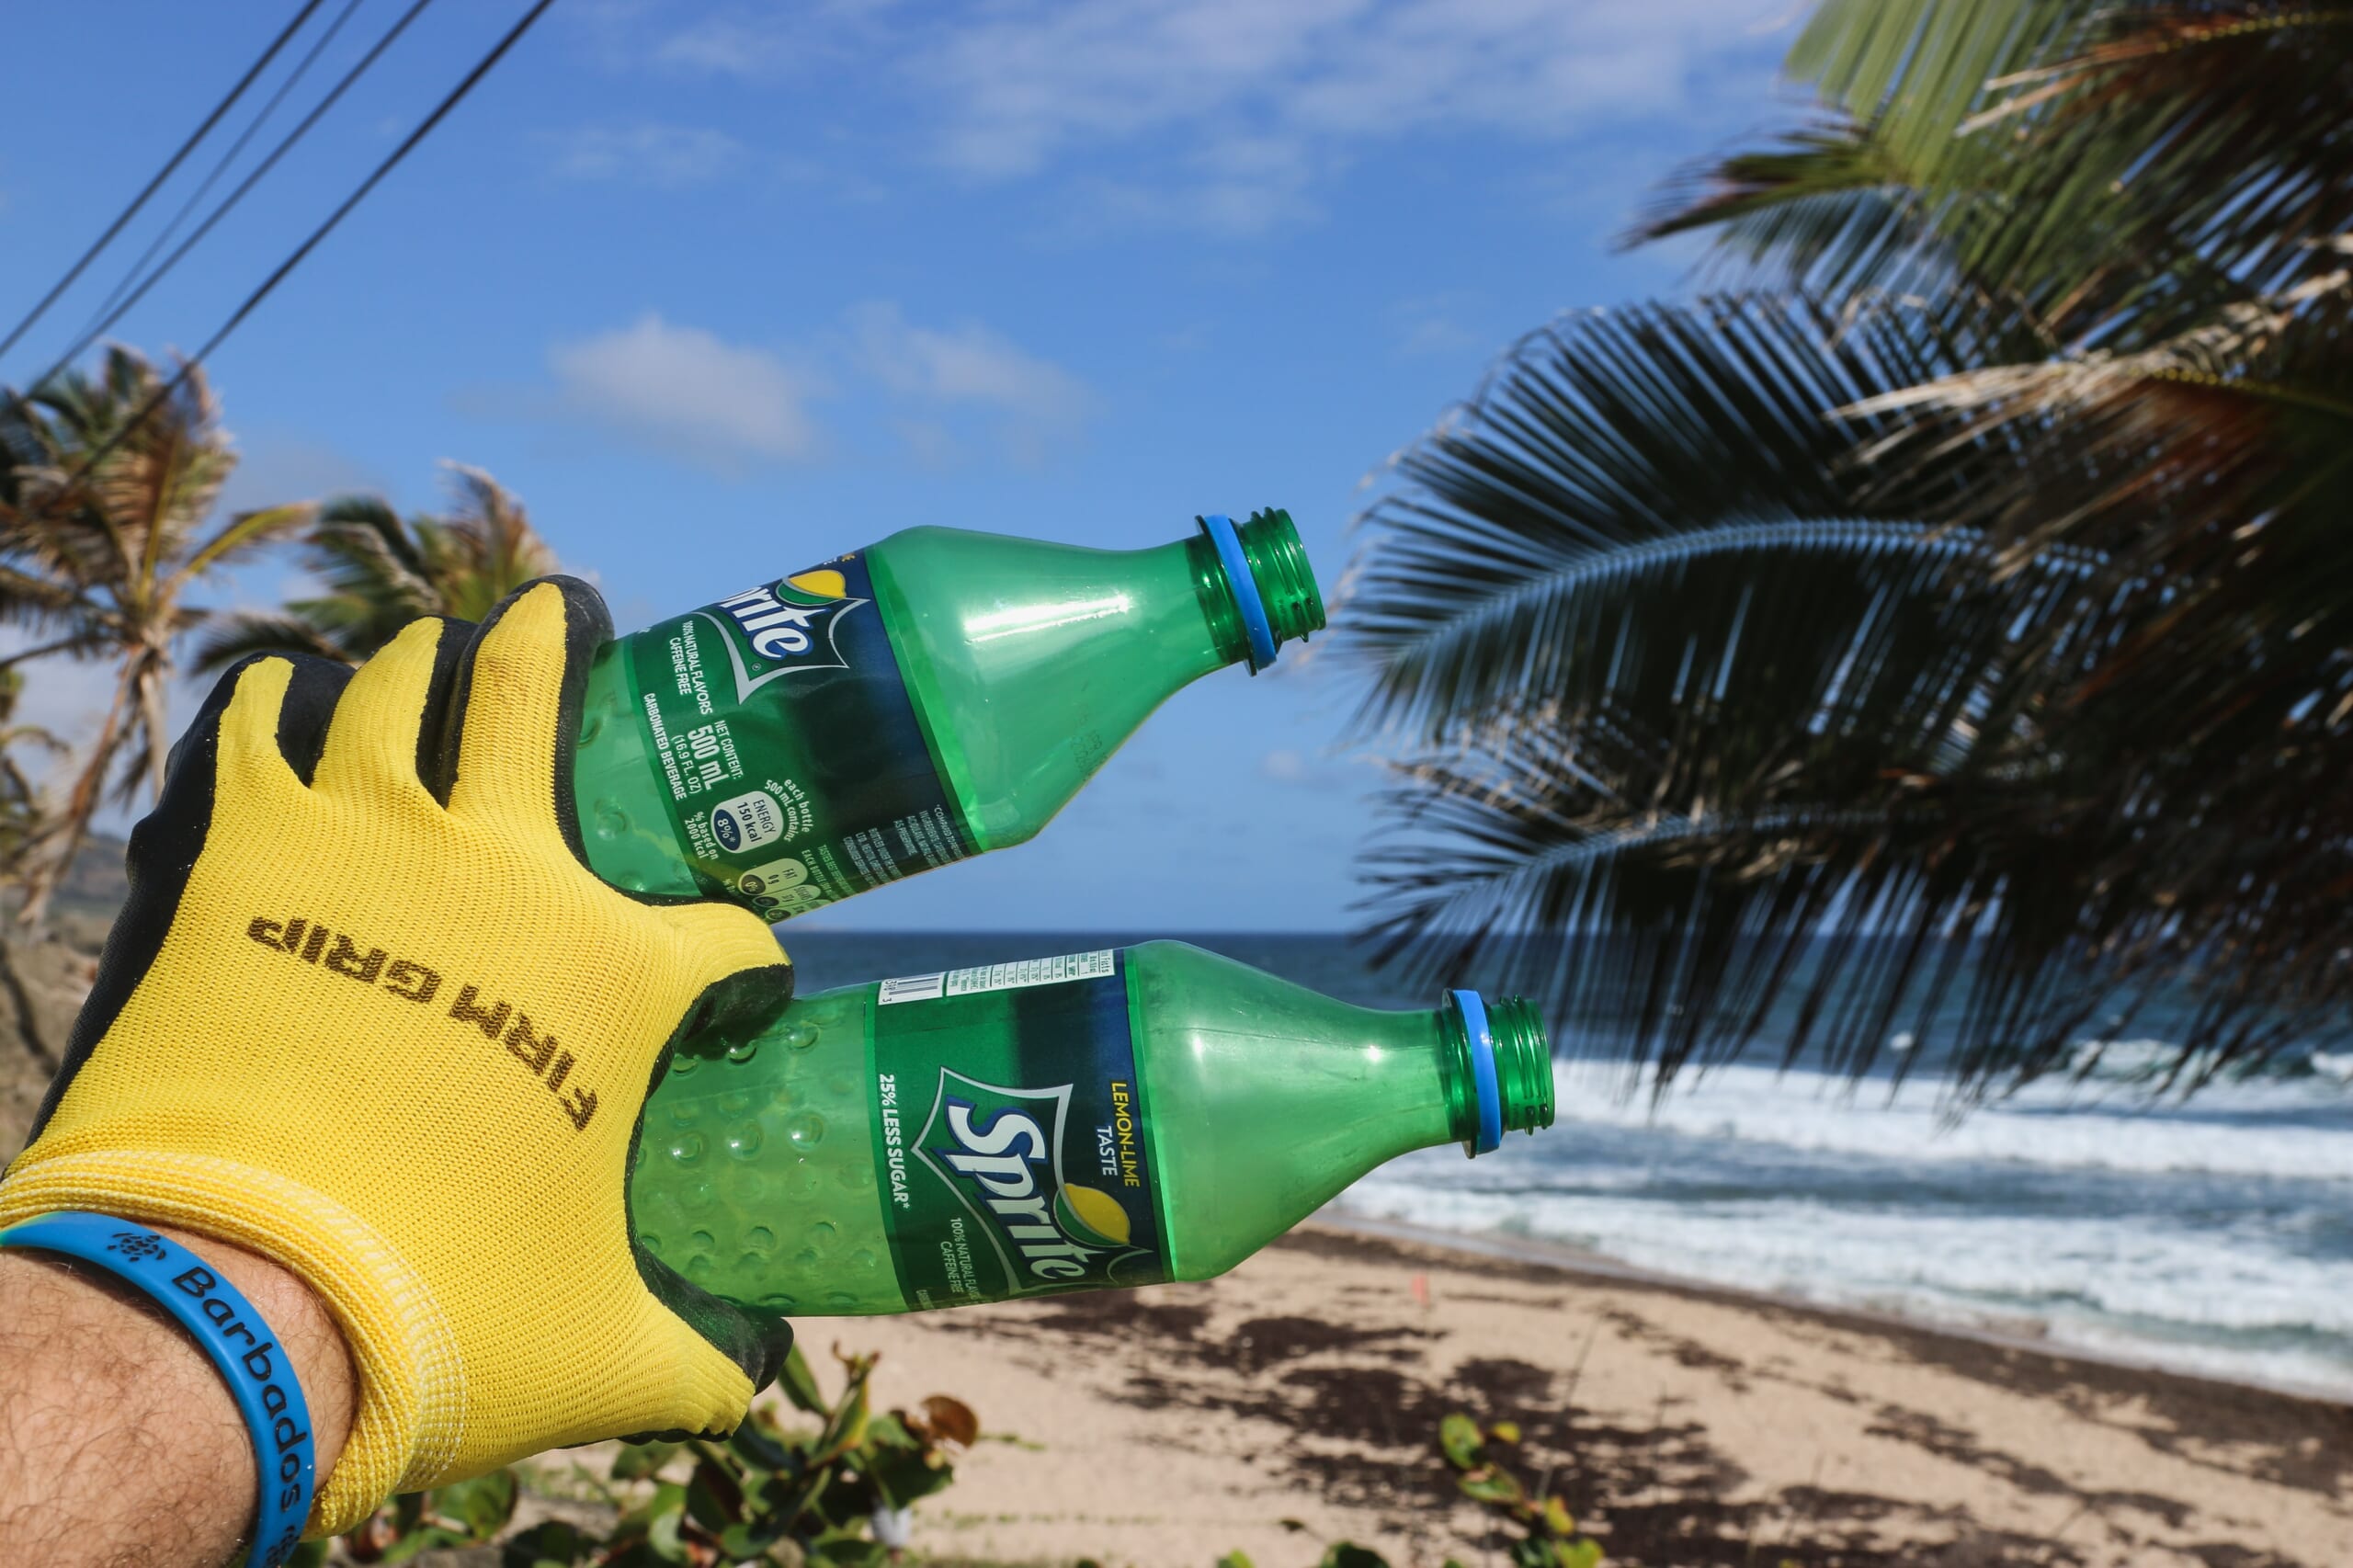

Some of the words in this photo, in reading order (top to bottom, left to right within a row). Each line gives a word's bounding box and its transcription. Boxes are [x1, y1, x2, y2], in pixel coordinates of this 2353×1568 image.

[719, 586, 826, 658] rite
[669, 637, 688, 673] CAFFEINE
[684, 636, 701, 671] NATURAL
[676, 672, 692, 696] FREE
[691, 670, 713, 714] FLAVORS
[671, 734, 689, 759] (16.9
[688, 724, 720, 760] 500
[714, 720, 730, 737] NET
[643, 693, 669, 749] CARBONATED
[661, 750, 688, 801] BEVERAGE
[721, 736, 745, 779] CONTENT:
[684, 759, 699, 778] FL.
[688, 776, 702, 794] OZ)
[699, 760, 730, 790] mL
[764, 779, 782, 795] 500
[780, 793, 793, 809] mL
[736, 801, 752, 822] 150
[745, 820, 762, 843] kcal
[753, 799, 777, 834] ENERGY
[784, 779, 802, 801] each
[800, 801, 813, 833] bottle
[684, 818, 699, 840] 2000
[693, 838, 709, 858] kcal
[697, 820, 715, 847] based
[708, 846, 720, 860] on
[783, 807, 800, 843] contains
[782, 868, 798, 881] FAT
[801, 849, 816, 866] EACH
[247, 917, 443, 1004] GRIP
[449, 984, 598, 1131] FIRM
[878, 1074, 898, 1107] 25%
[881, 1107, 901, 1146] LESS
[1110, 1081, 1141, 1187] LEMON-LIME
[1097, 1124, 1118, 1176] TASTE
[943, 1102, 1108, 1280] Sprite
[949, 1217, 966, 1242] 100%
[940, 1241, 961, 1279] CAFFEINE
[956, 1243, 975, 1279] NATURAL
[949, 1279, 964, 1293] FREE
[172, 1266, 308, 1513] Barbados
